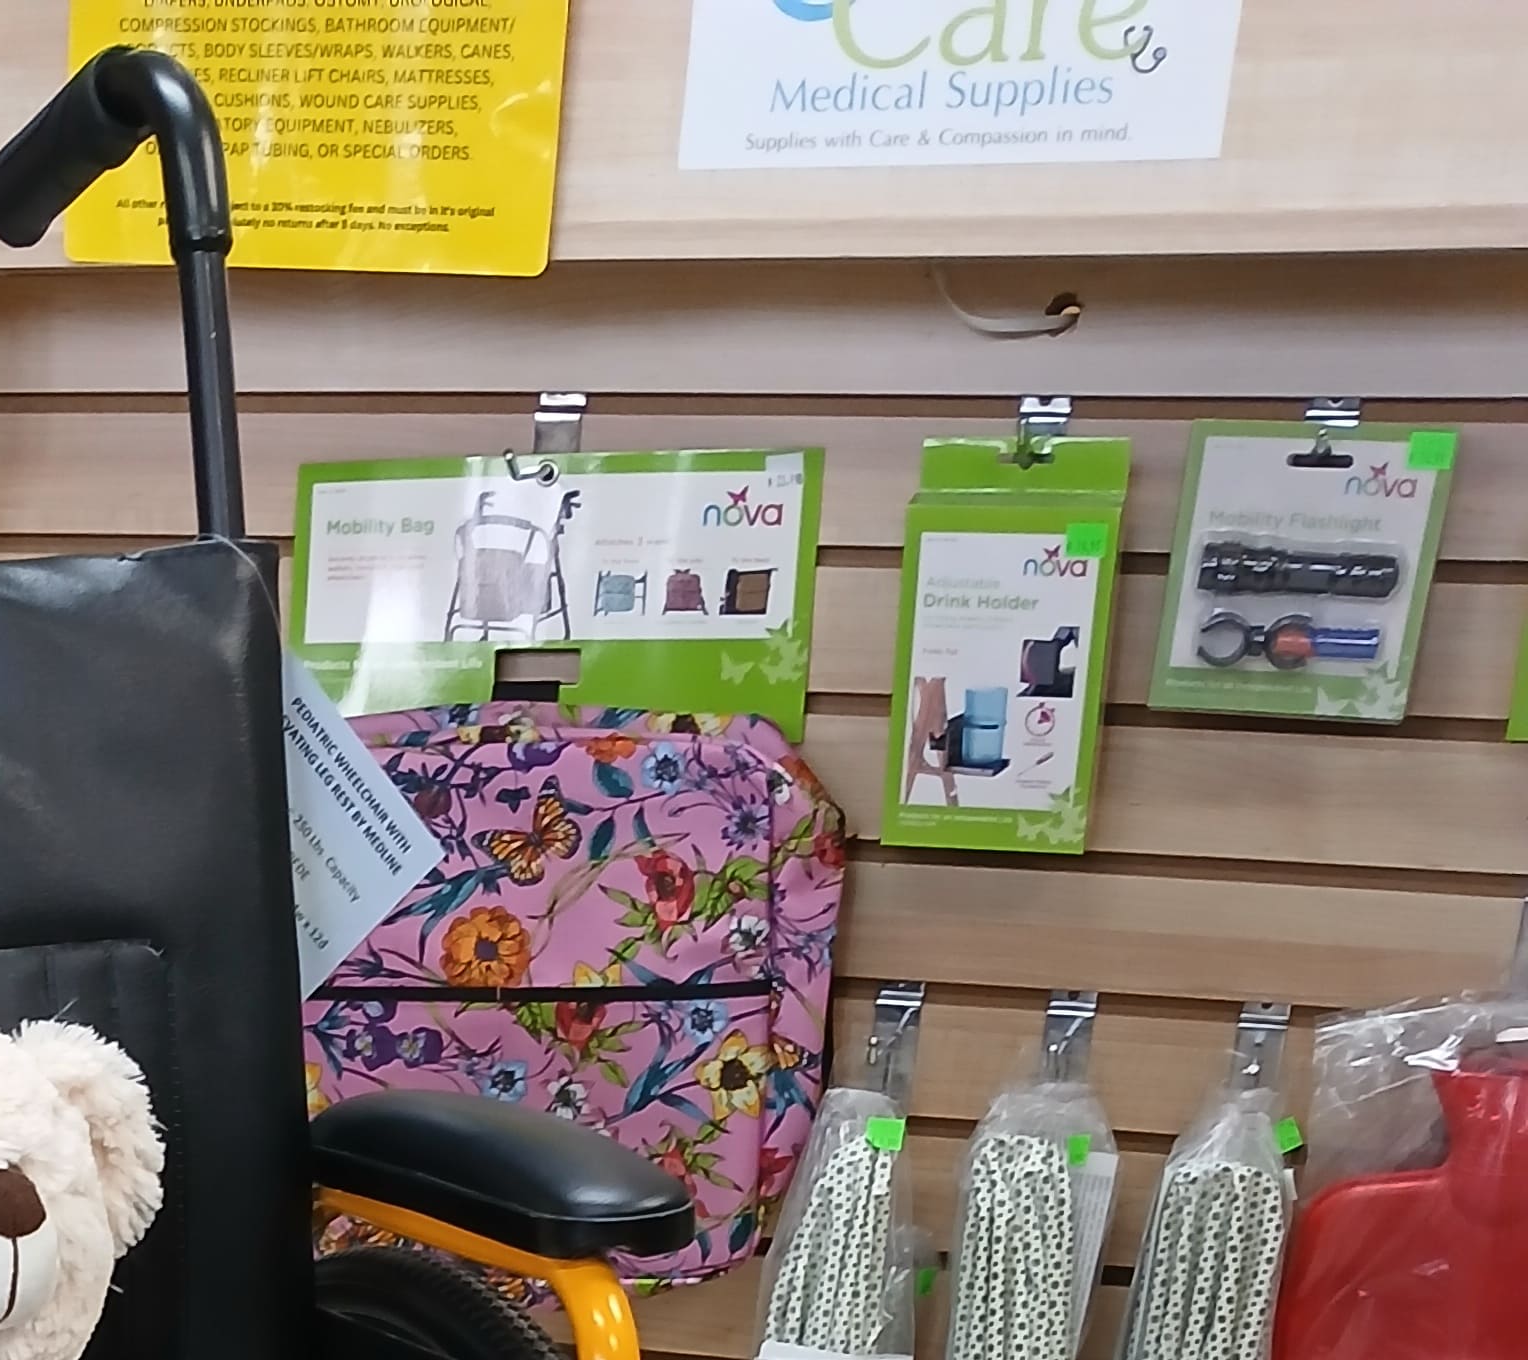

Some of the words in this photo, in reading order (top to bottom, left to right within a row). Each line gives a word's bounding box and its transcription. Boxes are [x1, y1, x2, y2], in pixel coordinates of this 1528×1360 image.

[119, 17, 227, 33] COMPRESSION
[230, 17, 321, 34] STOCKINGS,
[325, 17, 415, 33] BATHROOM
[419, 17, 517, 36] EQUIPMENT/
[774, 0, 1150, 69] Care
[204, 43, 245, 58] BODY
[382, 44, 456, 61] WALKERS,
[460, 44, 516, 62] CANES,
[218, 68, 290, 83] RECLINER
[294, 68, 325, 83] LIFT
[328, 68, 389, 86] CHAIRS,
[393, 69, 495, 87] MATTRESSES,
[769, 71, 927, 113] Medical
[945, 65, 1115, 117] Supplies
[214, 92, 295, 110] CUSHIONS,
[299, 93, 360, 109] WOUND
[407, 94, 482, 113] SUPPLIES,
[267, 117, 359, 135] EQUIPMENT,
[745, 132, 817, 153] Supplies
[824, 130, 862, 148] with
[869, 129, 910, 147] Care
[917, 130, 931, 145] &
[938, 127, 1049, 149] Compassion
[1055, 126, 1073, 142] in
[1079, 124, 1132, 143] mind.
[318, 142, 339, 158] OR
[1343, 476, 1418, 499] nova
[701, 503, 784, 527] nova
[1208, 511, 1284, 532] Mobility
[326, 517, 395, 538] Mobility
[401, 516, 436, 537] Bag
[1022, 557, 1088, 578] nova
[923, 592, 972, 610] Drink
[977, 594, 1040, 611] Holder
[290, 696, 340, 758] PEDIATRIC
[332, 752, 389, 827] WHEELCHAIR
[381, 819, 413, 855] WITH
[311, 761, 334, 788] LEG
[328, 781, 356, 816] REST
[349, 808, 368, 830] BY
[361, 824, 404, 877] MEDLINE
[323, 855, 362, 904] Capacity
